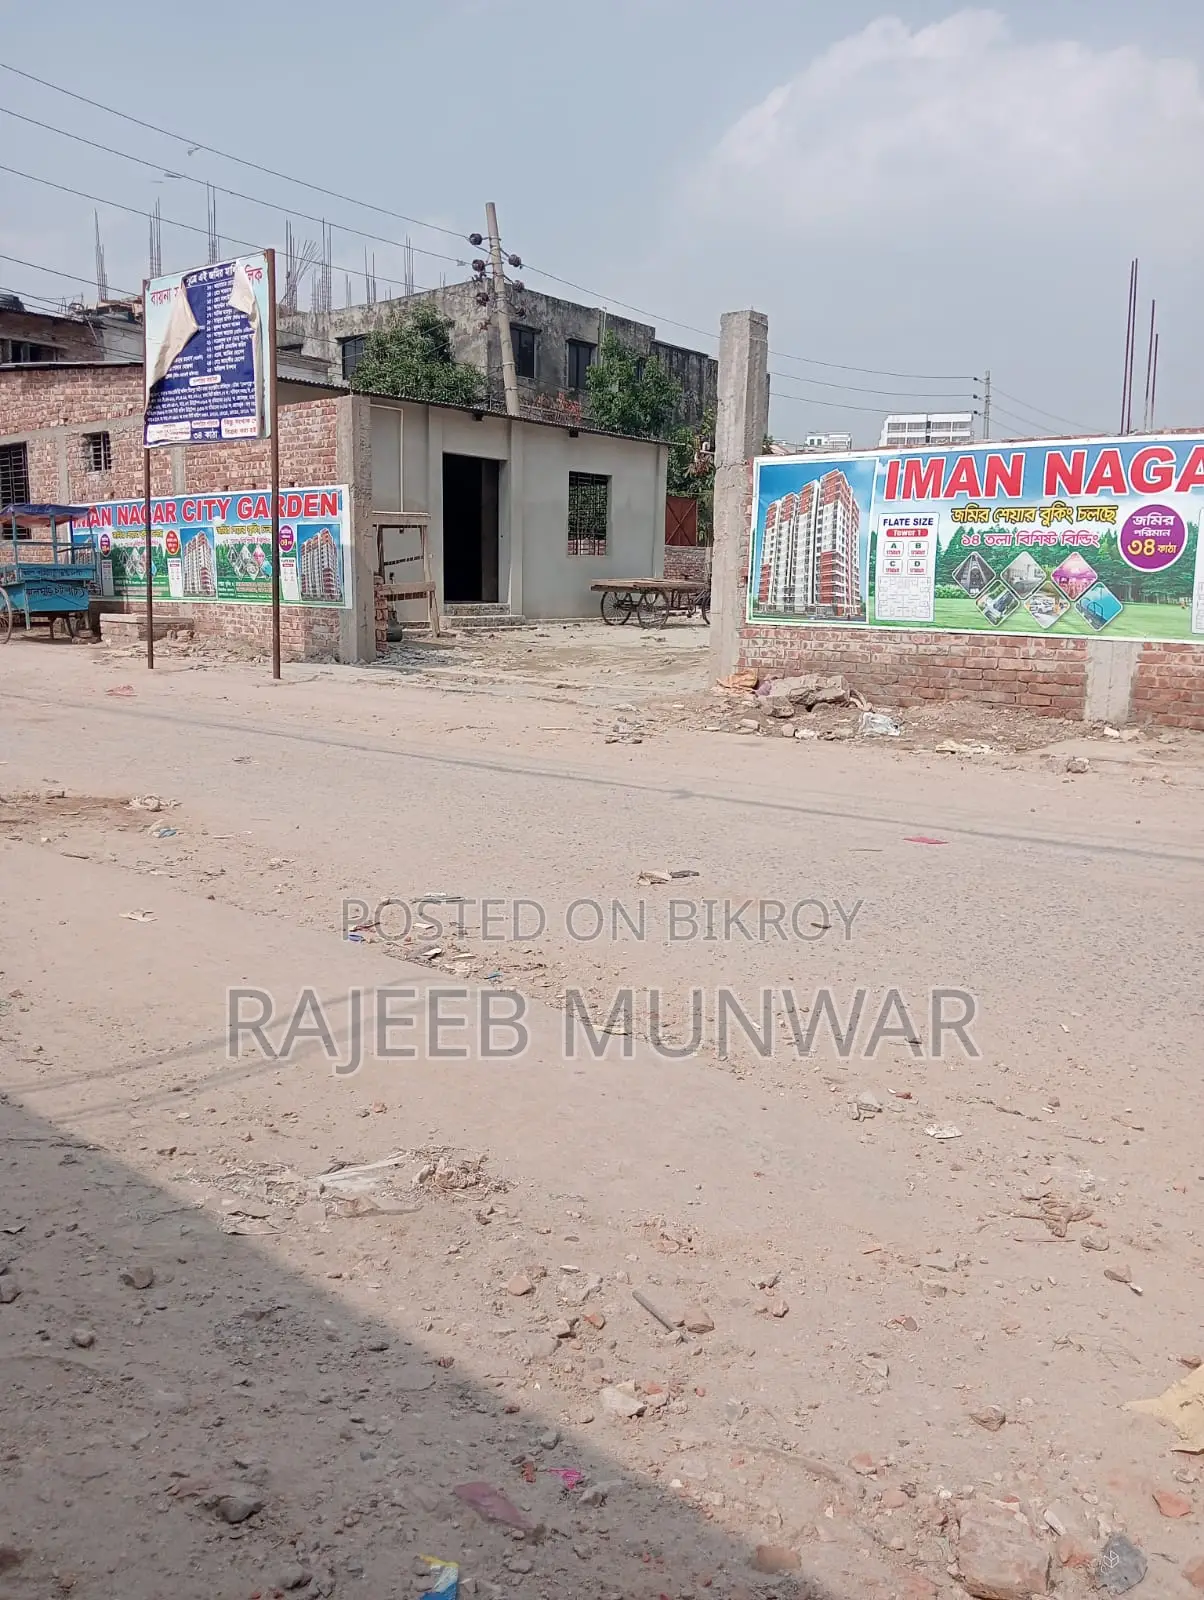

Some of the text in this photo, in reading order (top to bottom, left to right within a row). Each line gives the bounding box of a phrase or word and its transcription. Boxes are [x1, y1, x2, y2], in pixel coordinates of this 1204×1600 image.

[883, 453, 1025, 501] IMAN
[182, 496, 231, 522] CITY
[951, 501, 1118, 526] জমির শেয়ার বুকিং চলছে
[883, 517, 934, 527] FLATE SIZE
[1132, 512, 1175, 526] জমির
[893, 529, 915, 537] Tower
[961, 534, 980, 546] ১৪
[984, 533, 1012, 545] তলা
[1015, 530, 1057, 546] বিশিষ্ট
[1127, 538, 1177, 556] ৩৪ কাঠা
